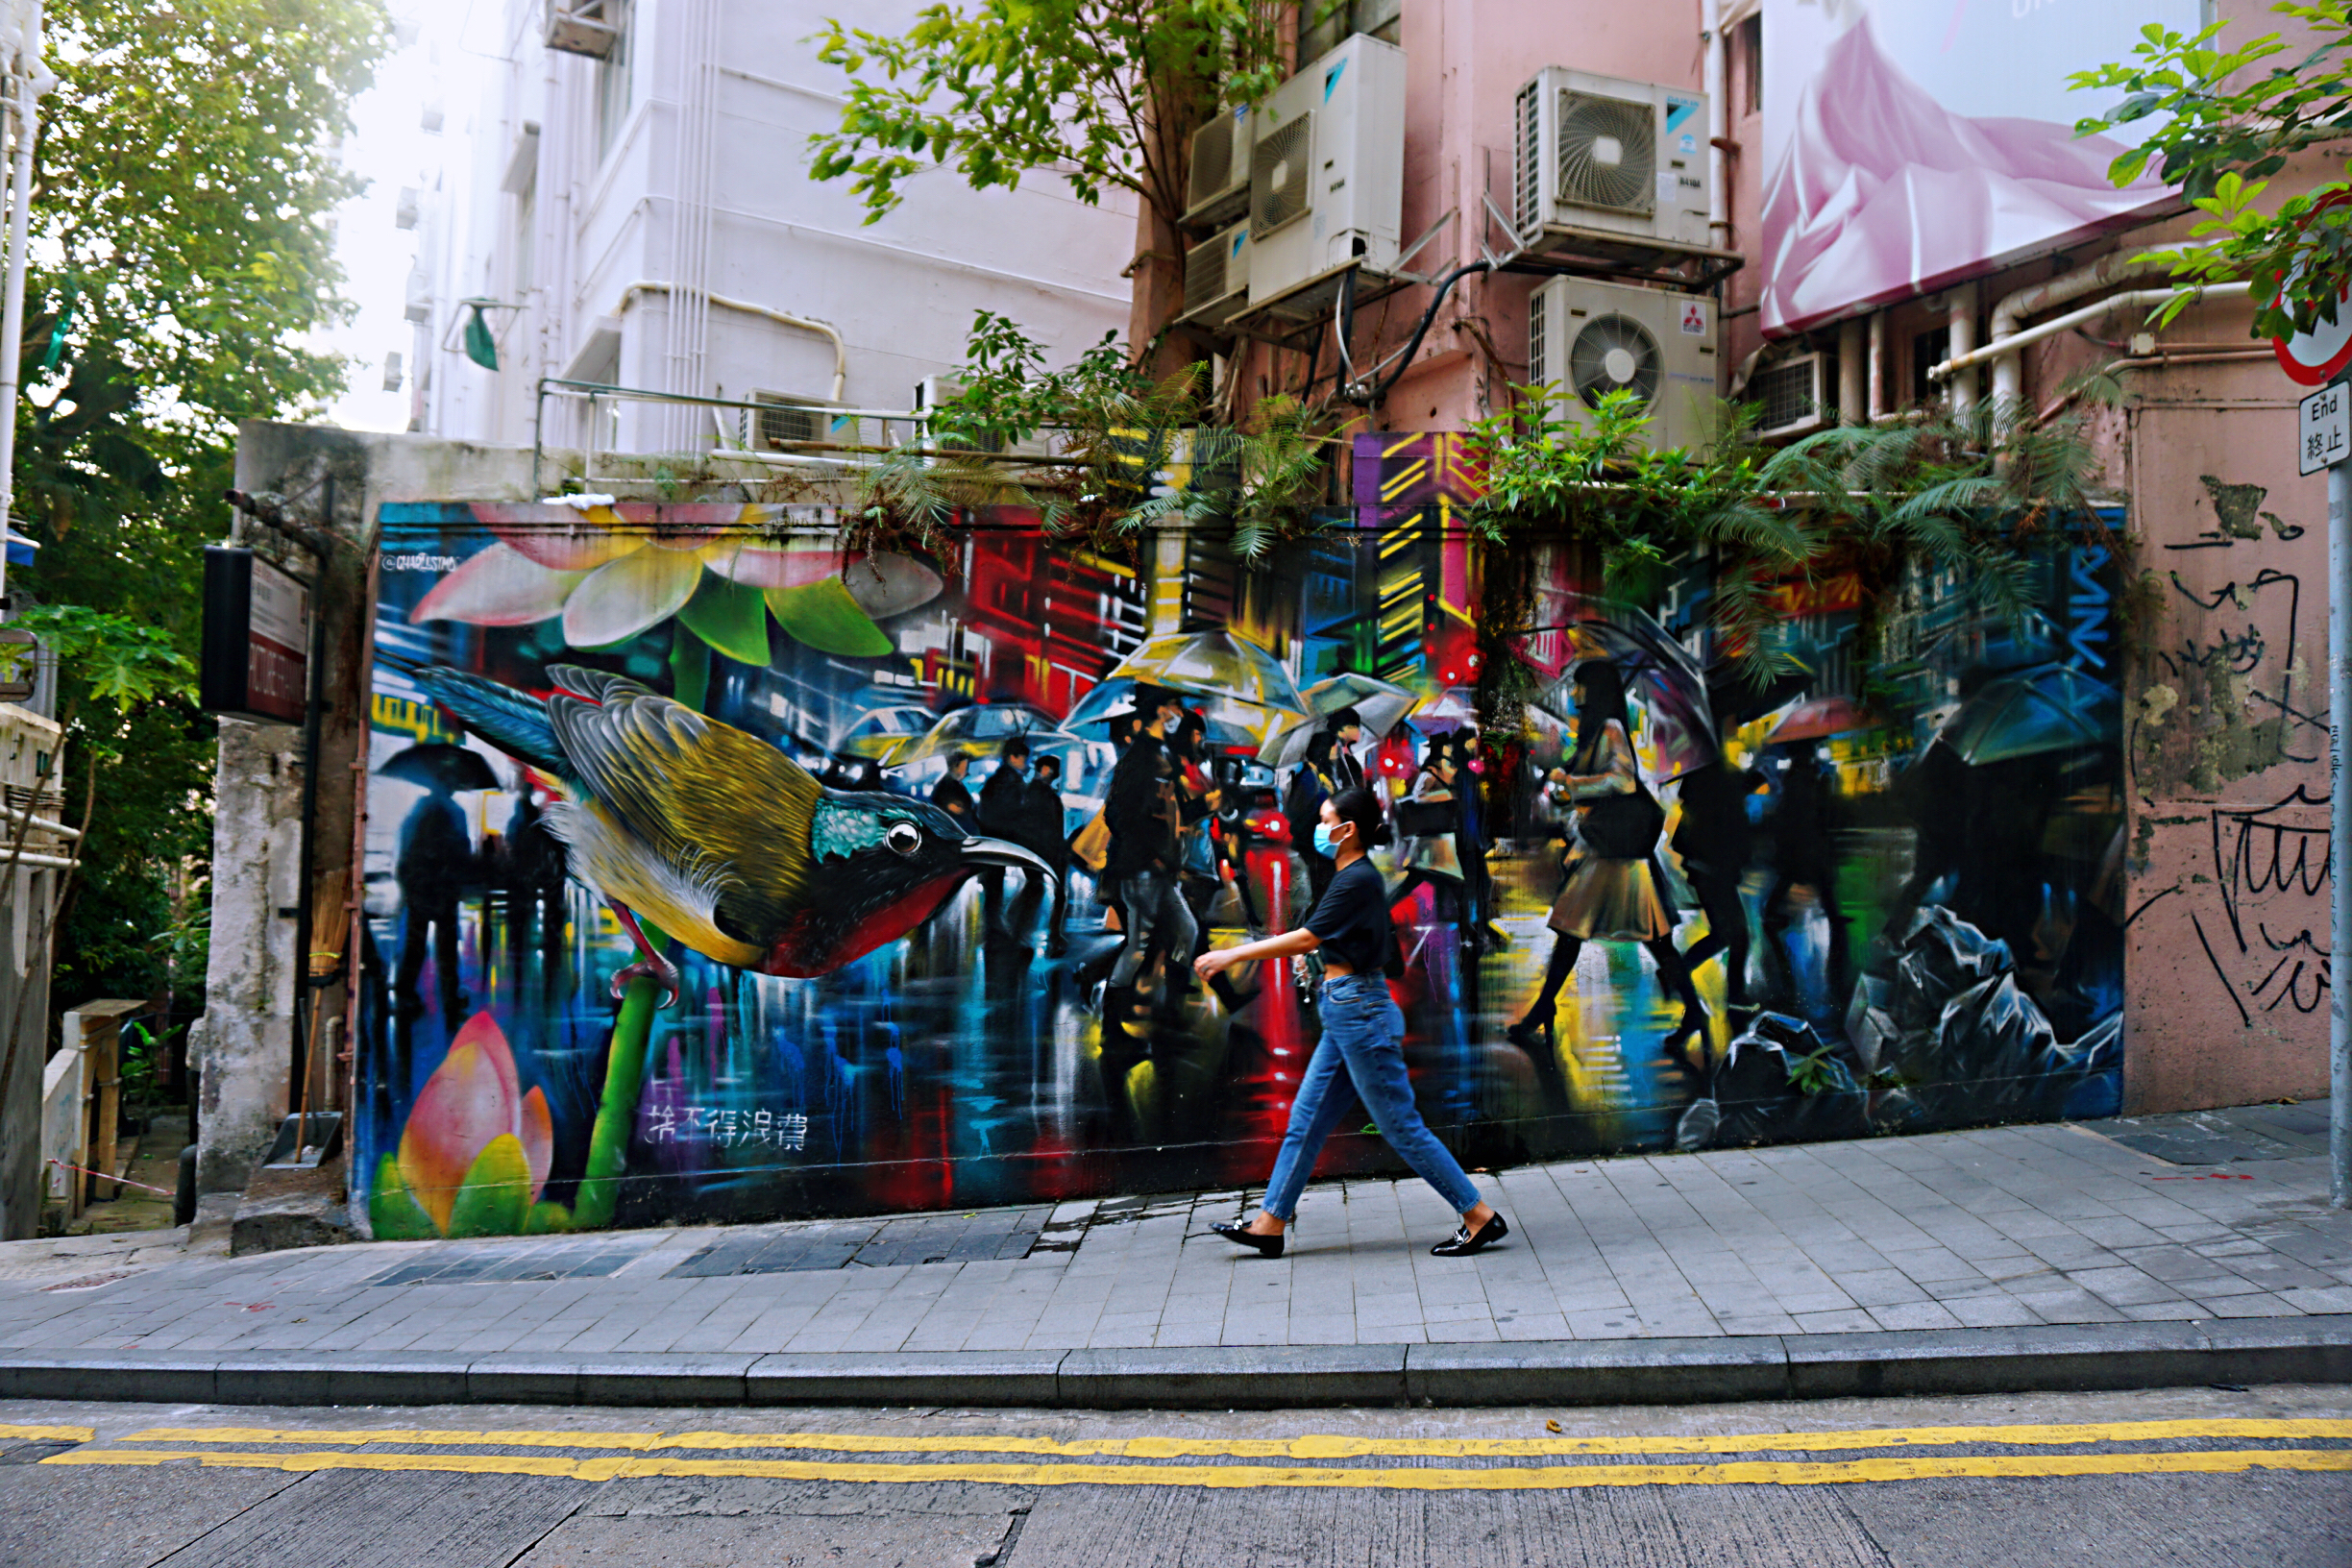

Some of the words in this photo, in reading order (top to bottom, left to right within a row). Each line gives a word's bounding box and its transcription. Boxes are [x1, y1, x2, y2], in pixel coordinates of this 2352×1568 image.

[1667, 95, 1700, 108] DAIKIN
[1679, 176, 1702, 188] R410A
[2312, 394, 2338, 422] End
[2307, 425, 2343, 460] 終止
[644, 1105, 808, 1151] 捨不得浪費
